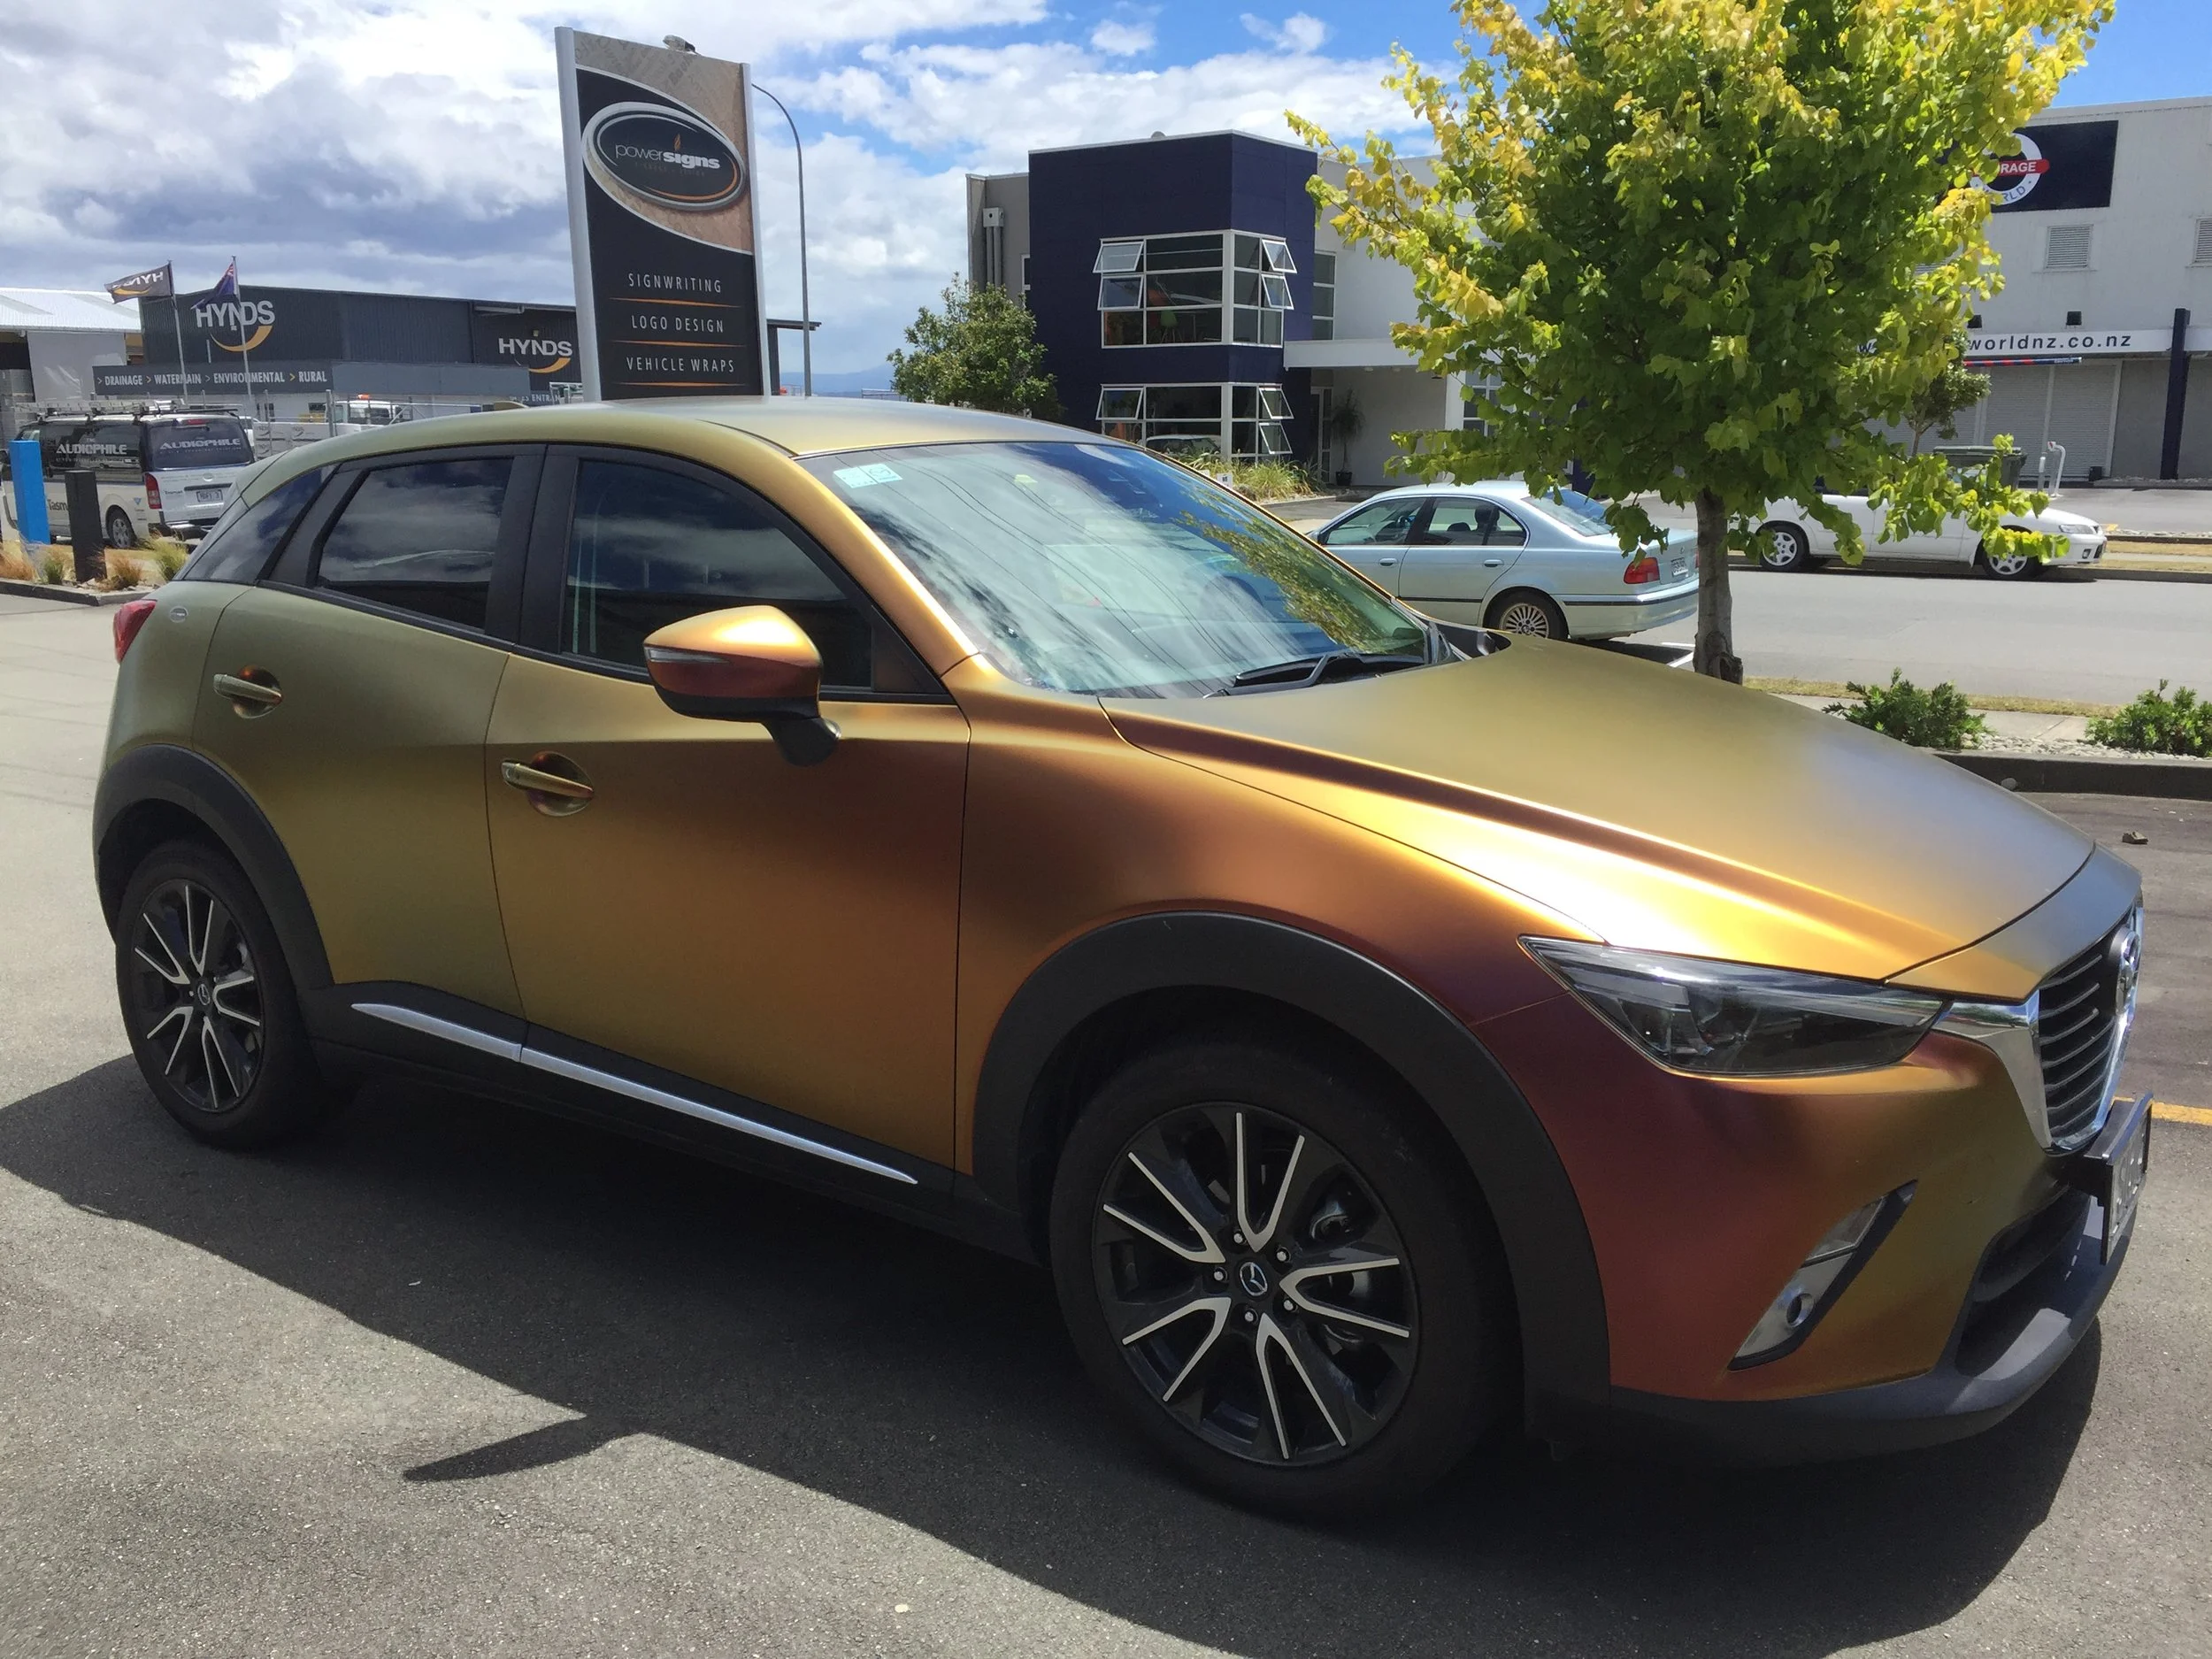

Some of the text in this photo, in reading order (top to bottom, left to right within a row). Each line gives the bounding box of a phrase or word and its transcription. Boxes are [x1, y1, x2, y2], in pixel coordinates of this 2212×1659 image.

[2001, 161, 2037, 173] RAGE
[628, 273, 721, 293] SIGNWRITING
[196, 300, 275, 328] HYNDS
[632, 315, 724, 333] LOGO DESIGN
[498, 338, 573, 357] HYNDS
[626, 357, 734, 373] VEHICLE WRAPS
[104, 374, 143, 386] DRAINAGE
[298, 371, 327, 382] RURAL
[56, 443, 127, 455] AUDIOPHILE
[159, 438, 241, 450] AUDIOPHILE
